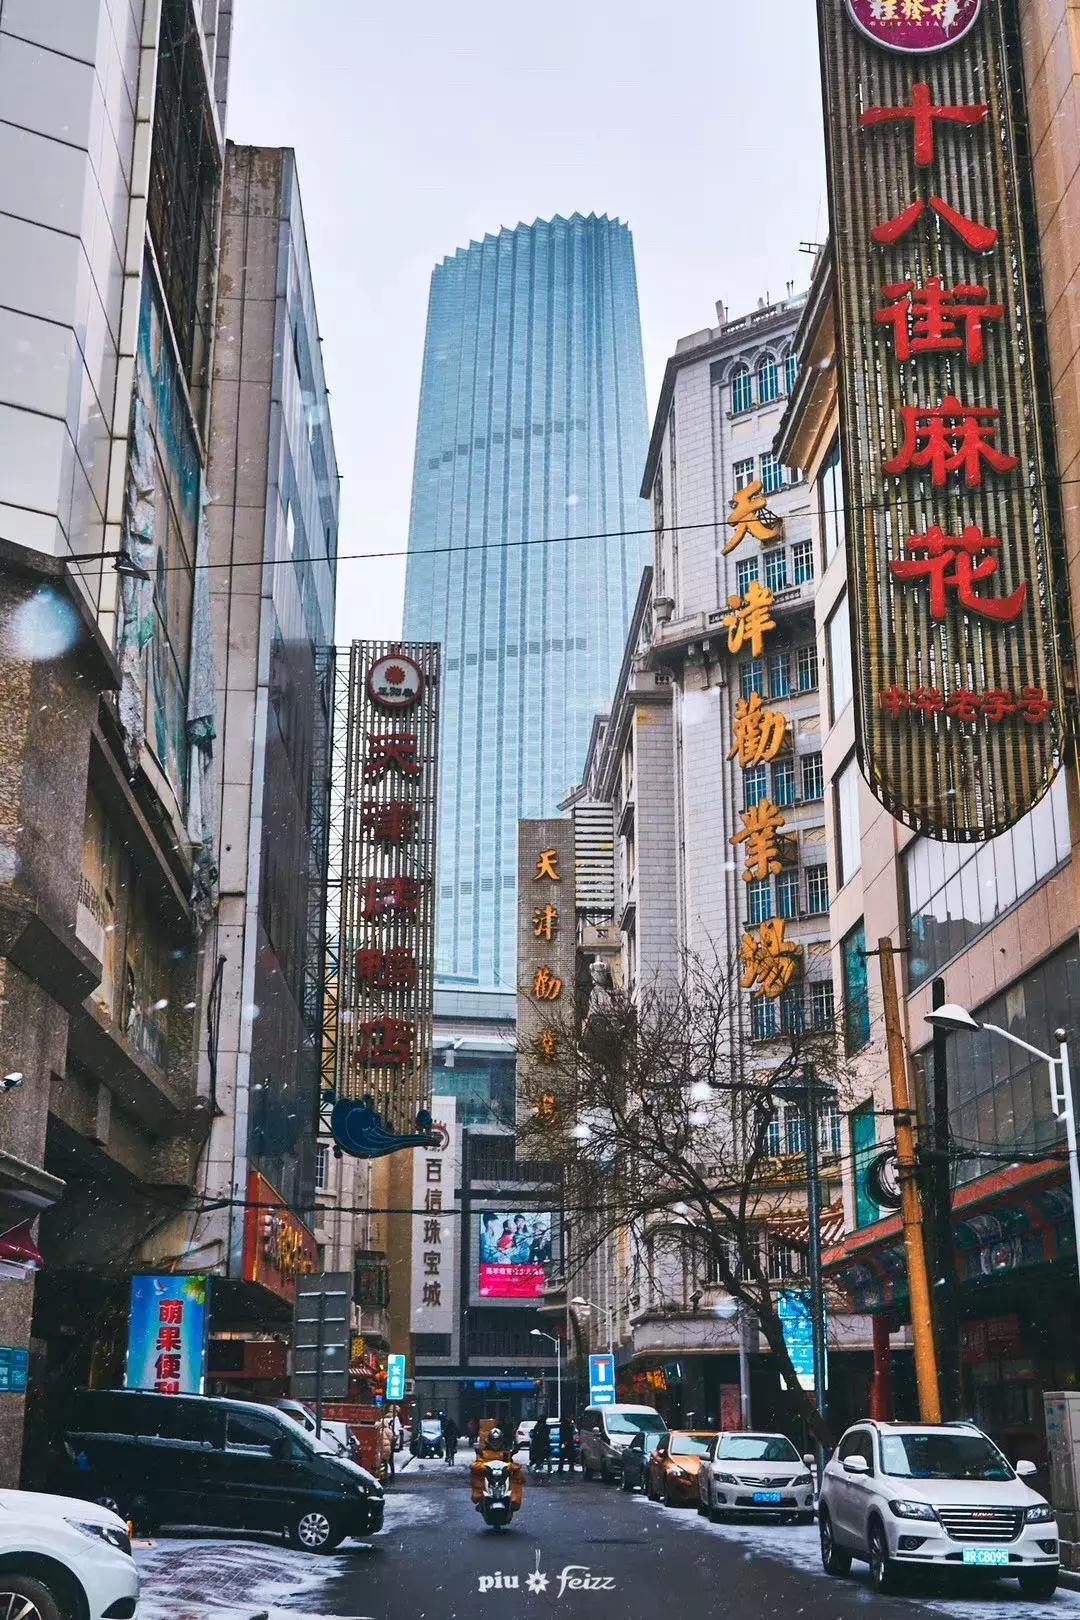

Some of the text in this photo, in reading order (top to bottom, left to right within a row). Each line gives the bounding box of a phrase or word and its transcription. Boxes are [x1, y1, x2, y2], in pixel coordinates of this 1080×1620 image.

[860, 82, 1028, 621] 十八街麻花
[880, 685, 1053, 723] 中华老字号
[422, 1158, 443, 1307] 百信珠宝城
